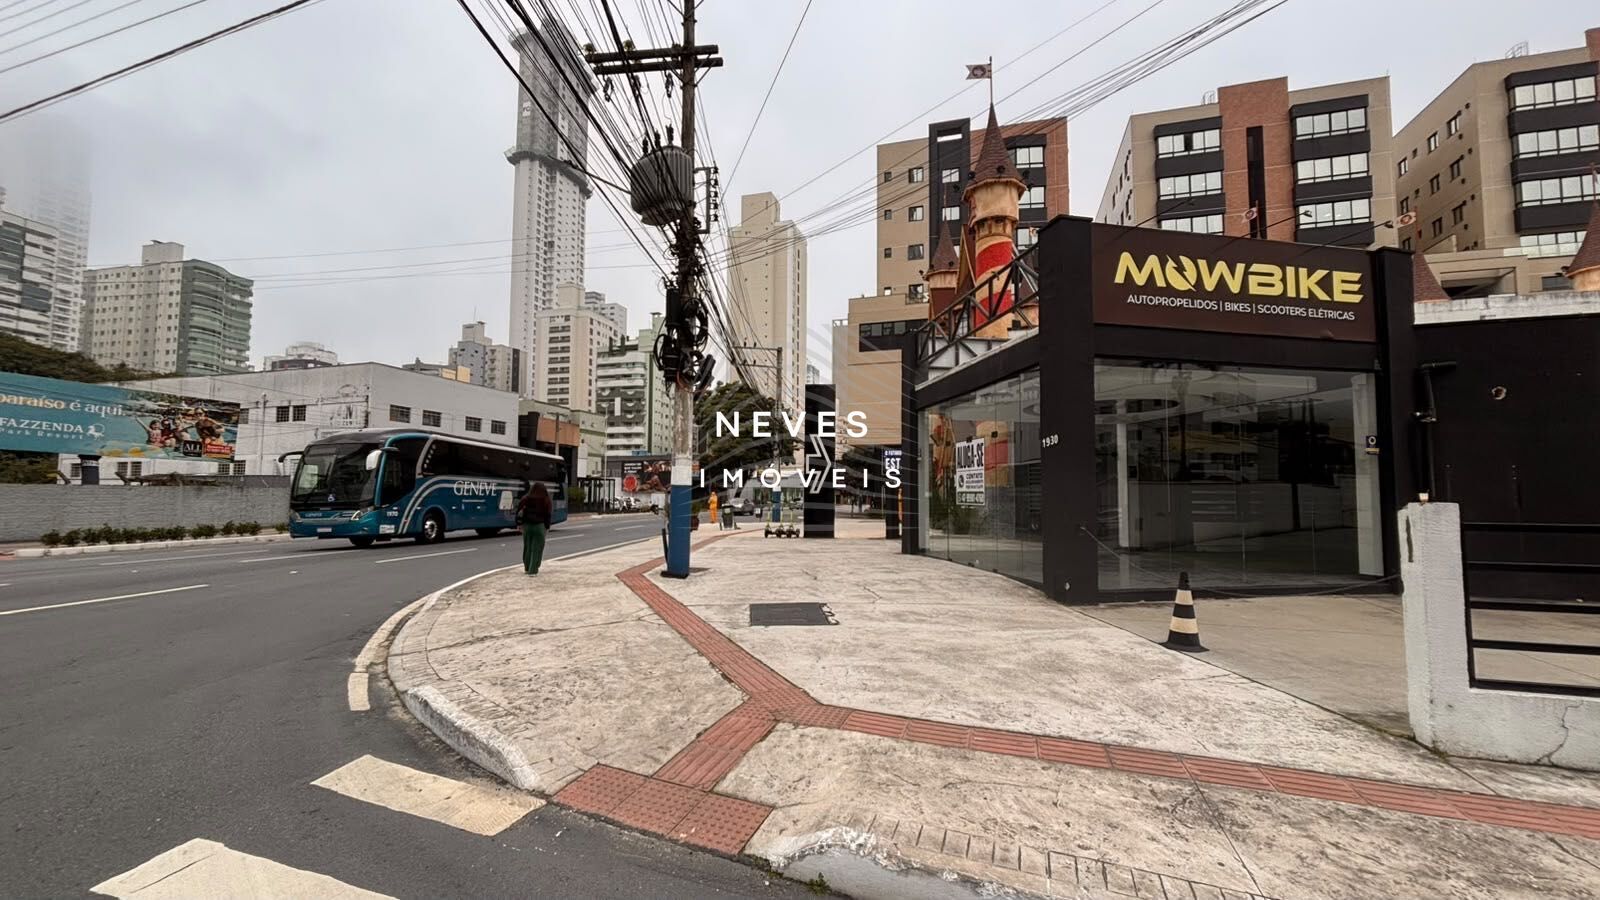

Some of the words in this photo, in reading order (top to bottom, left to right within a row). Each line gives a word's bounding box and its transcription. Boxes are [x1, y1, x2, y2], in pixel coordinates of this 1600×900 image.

[1114, 251, 1364, 304] MOWBIKE
[1127, 294, 1218, 311] AUTOPROPELIDOS
[1224, 301, 1251, 313] BIKES
[1257, 304, 1307, 317] SCOOTERS
[1308, 307, 1355, 321] ELÉTRICAS
[69, 399, 81, 411] é
[84, 403, 126, 418] aqui.
[0, 417, 84, 433] FAZZENDA
[37, 431, 83, 440] Resort
[1042, 434, 1059, 448] 1930
